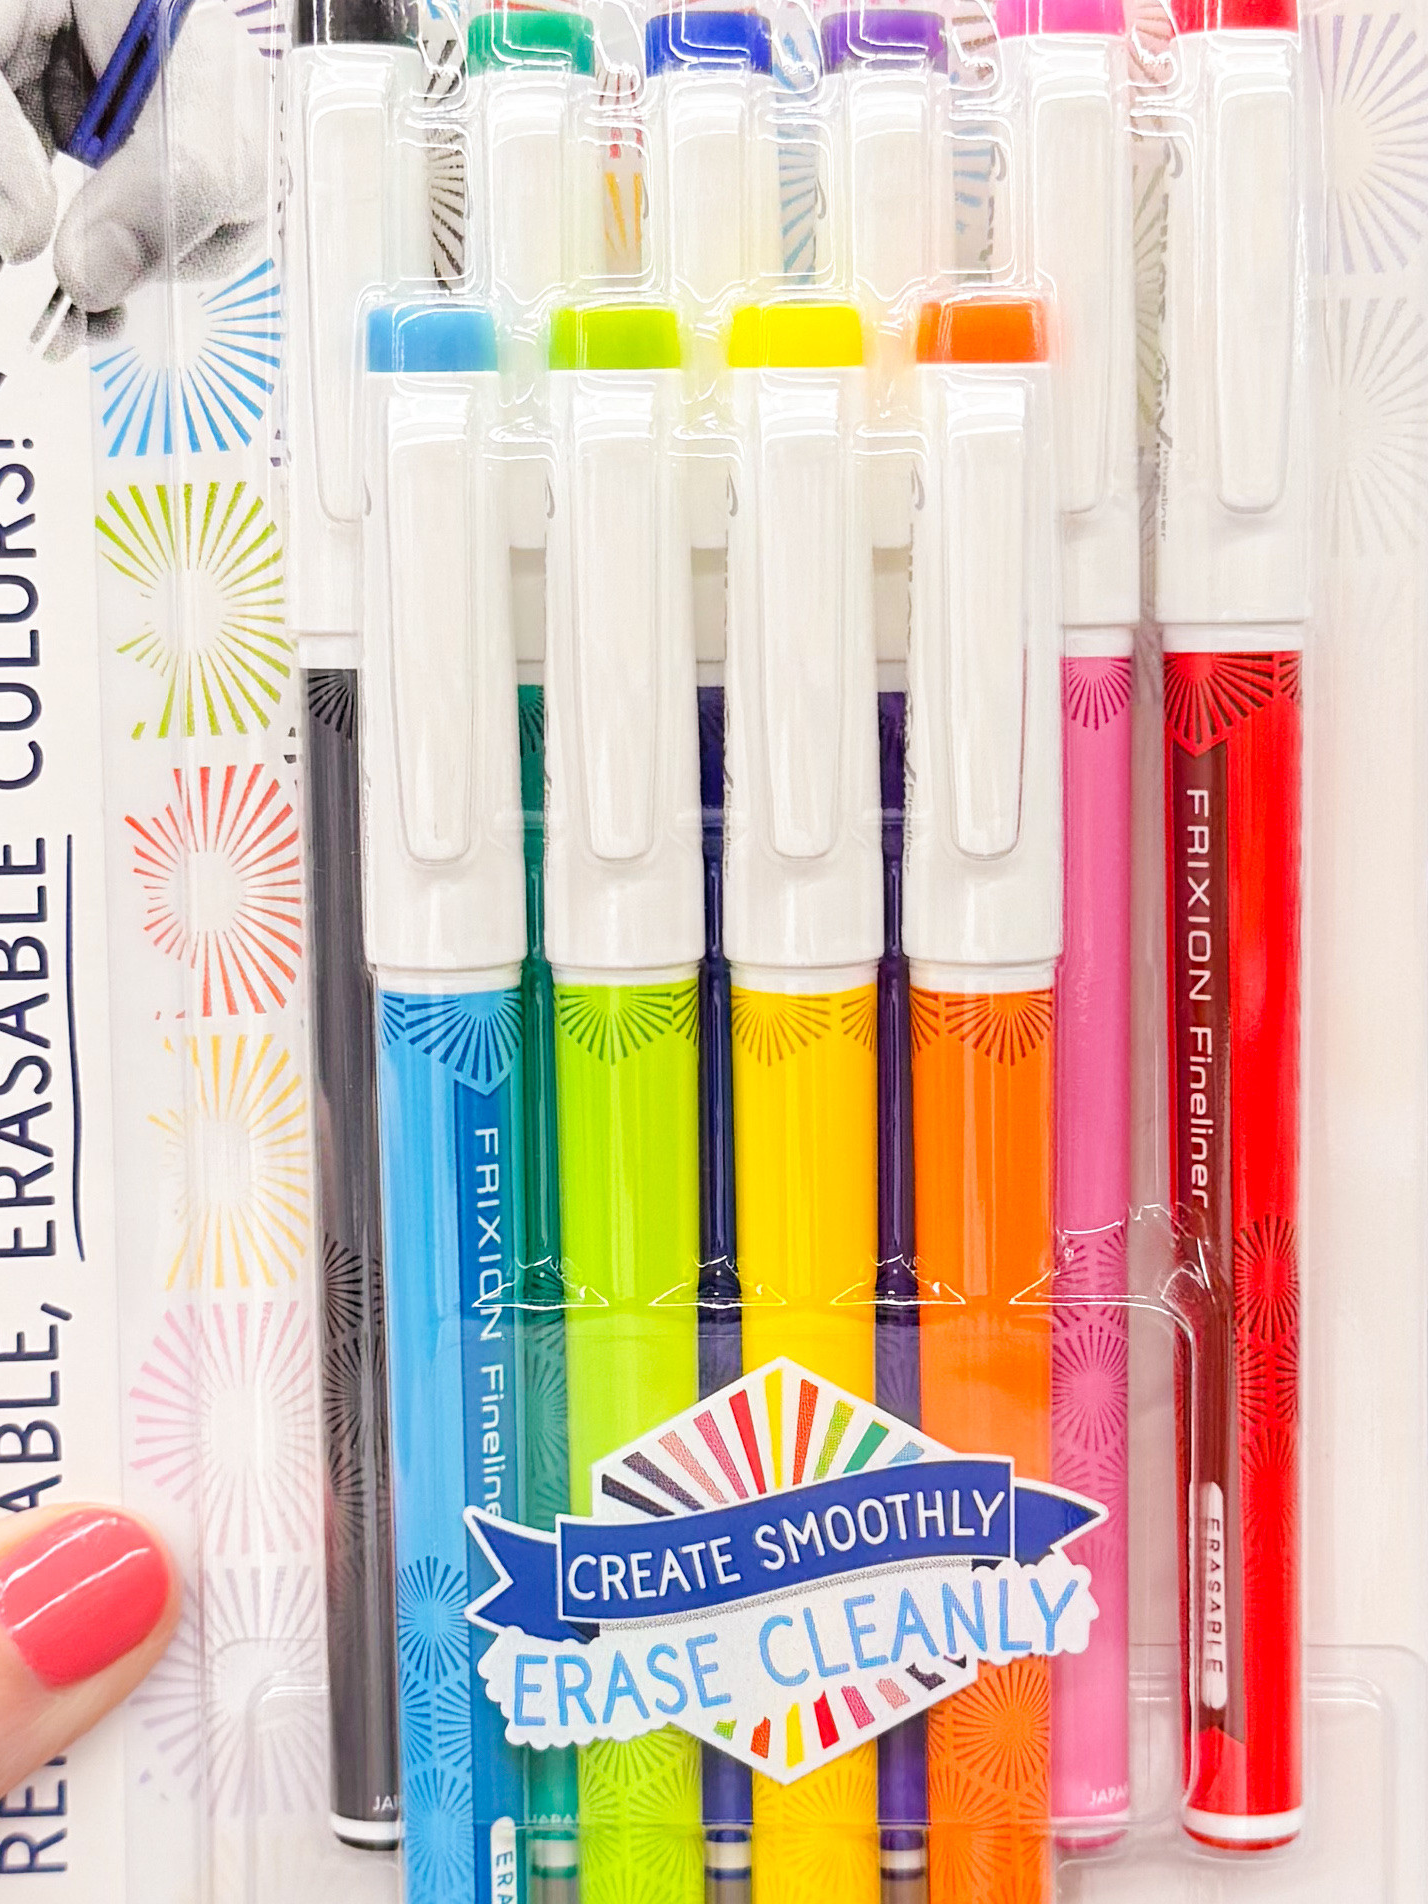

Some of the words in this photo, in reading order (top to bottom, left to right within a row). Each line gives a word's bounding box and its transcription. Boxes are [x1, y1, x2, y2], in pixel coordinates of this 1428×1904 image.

[1185, 787, 1215, 1004] FRIXION
[1186, 1024, 1213, 1210] Fineliner
[474, 1126, 507, 1343] FRIXION
[476, 1361, 510, 1524] Fineline
[567, 1536, 743, 1609] CREATE
[756, 1489, 1009, 1575] SMOOTHLY
[512, 1632, 733, 1729] ERASE
[759, 1577, 1082, 1691] CLEANLY
[1088, 1782, 1128, 1807] JAPA
